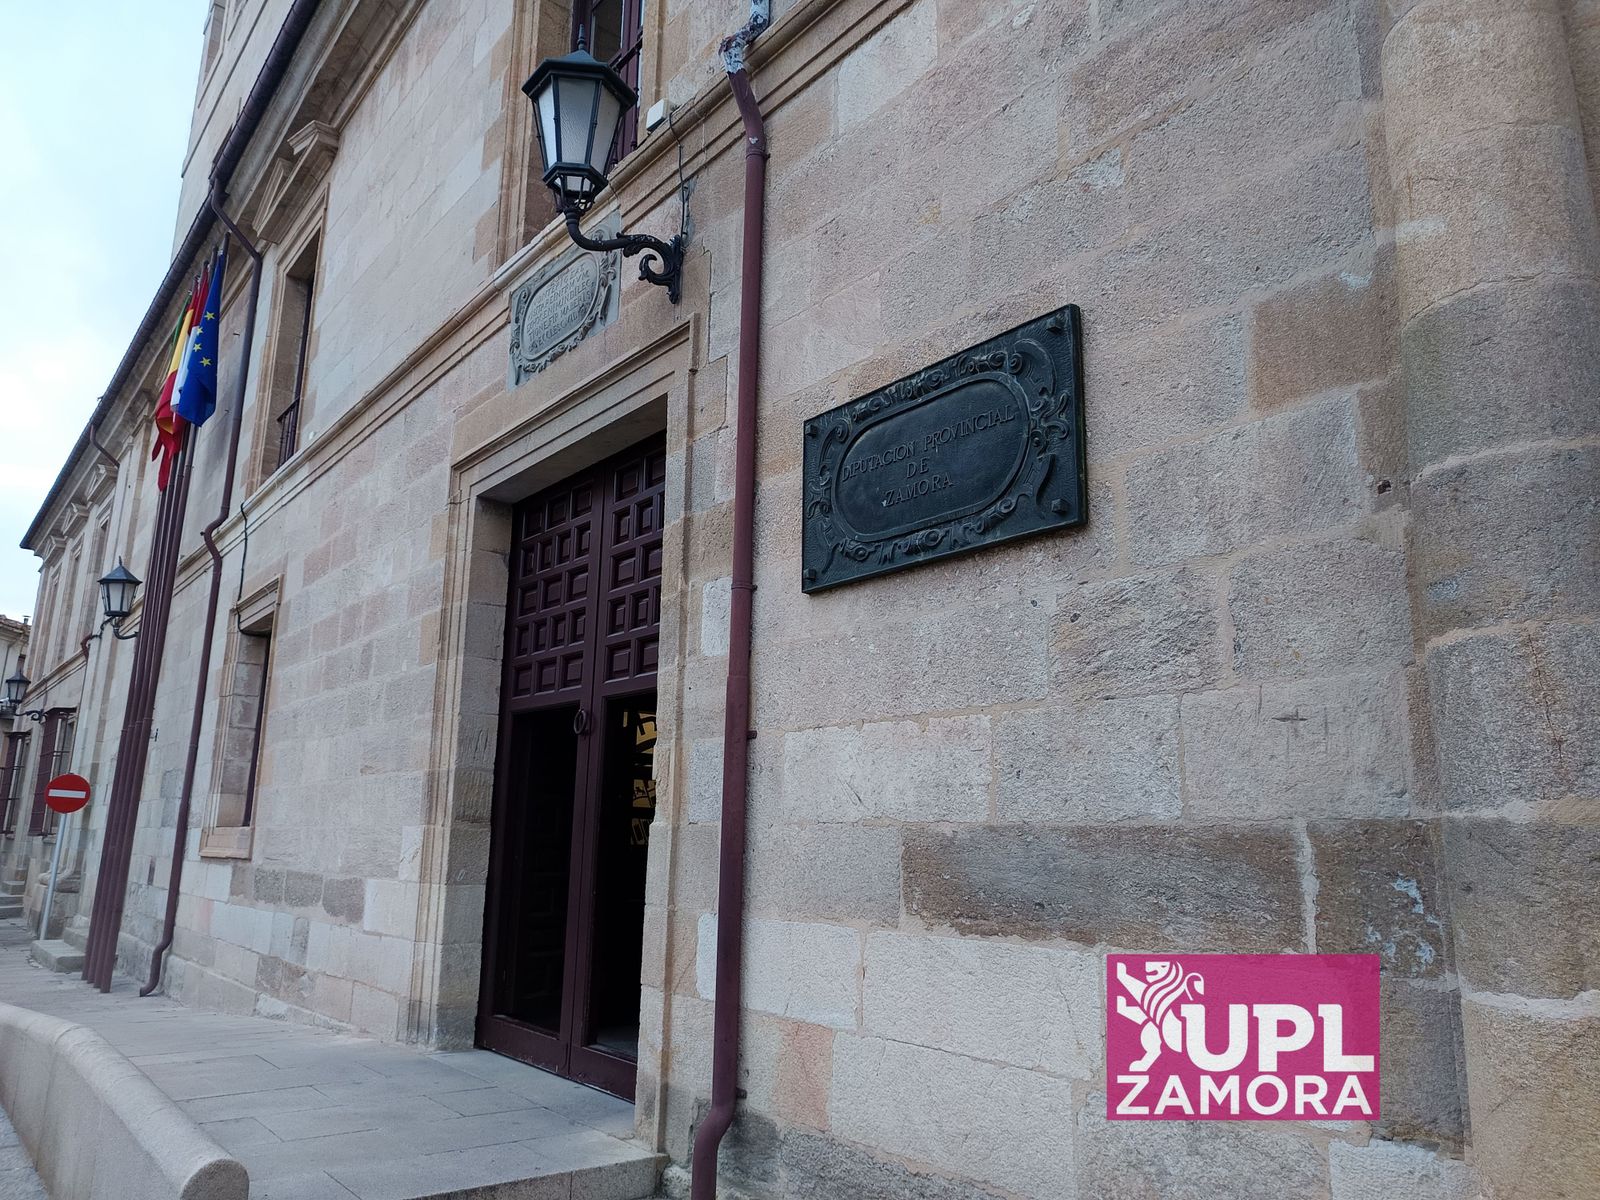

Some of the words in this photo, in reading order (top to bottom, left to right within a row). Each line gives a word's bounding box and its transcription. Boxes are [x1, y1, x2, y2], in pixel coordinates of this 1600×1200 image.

[841, 440, 916, 482] DIPUTACION
[923, 405, 1016, 452] PROVINCIAL
[906, 457, 930, 479] DE
[883, 472, 953, 506] ZAMORA
